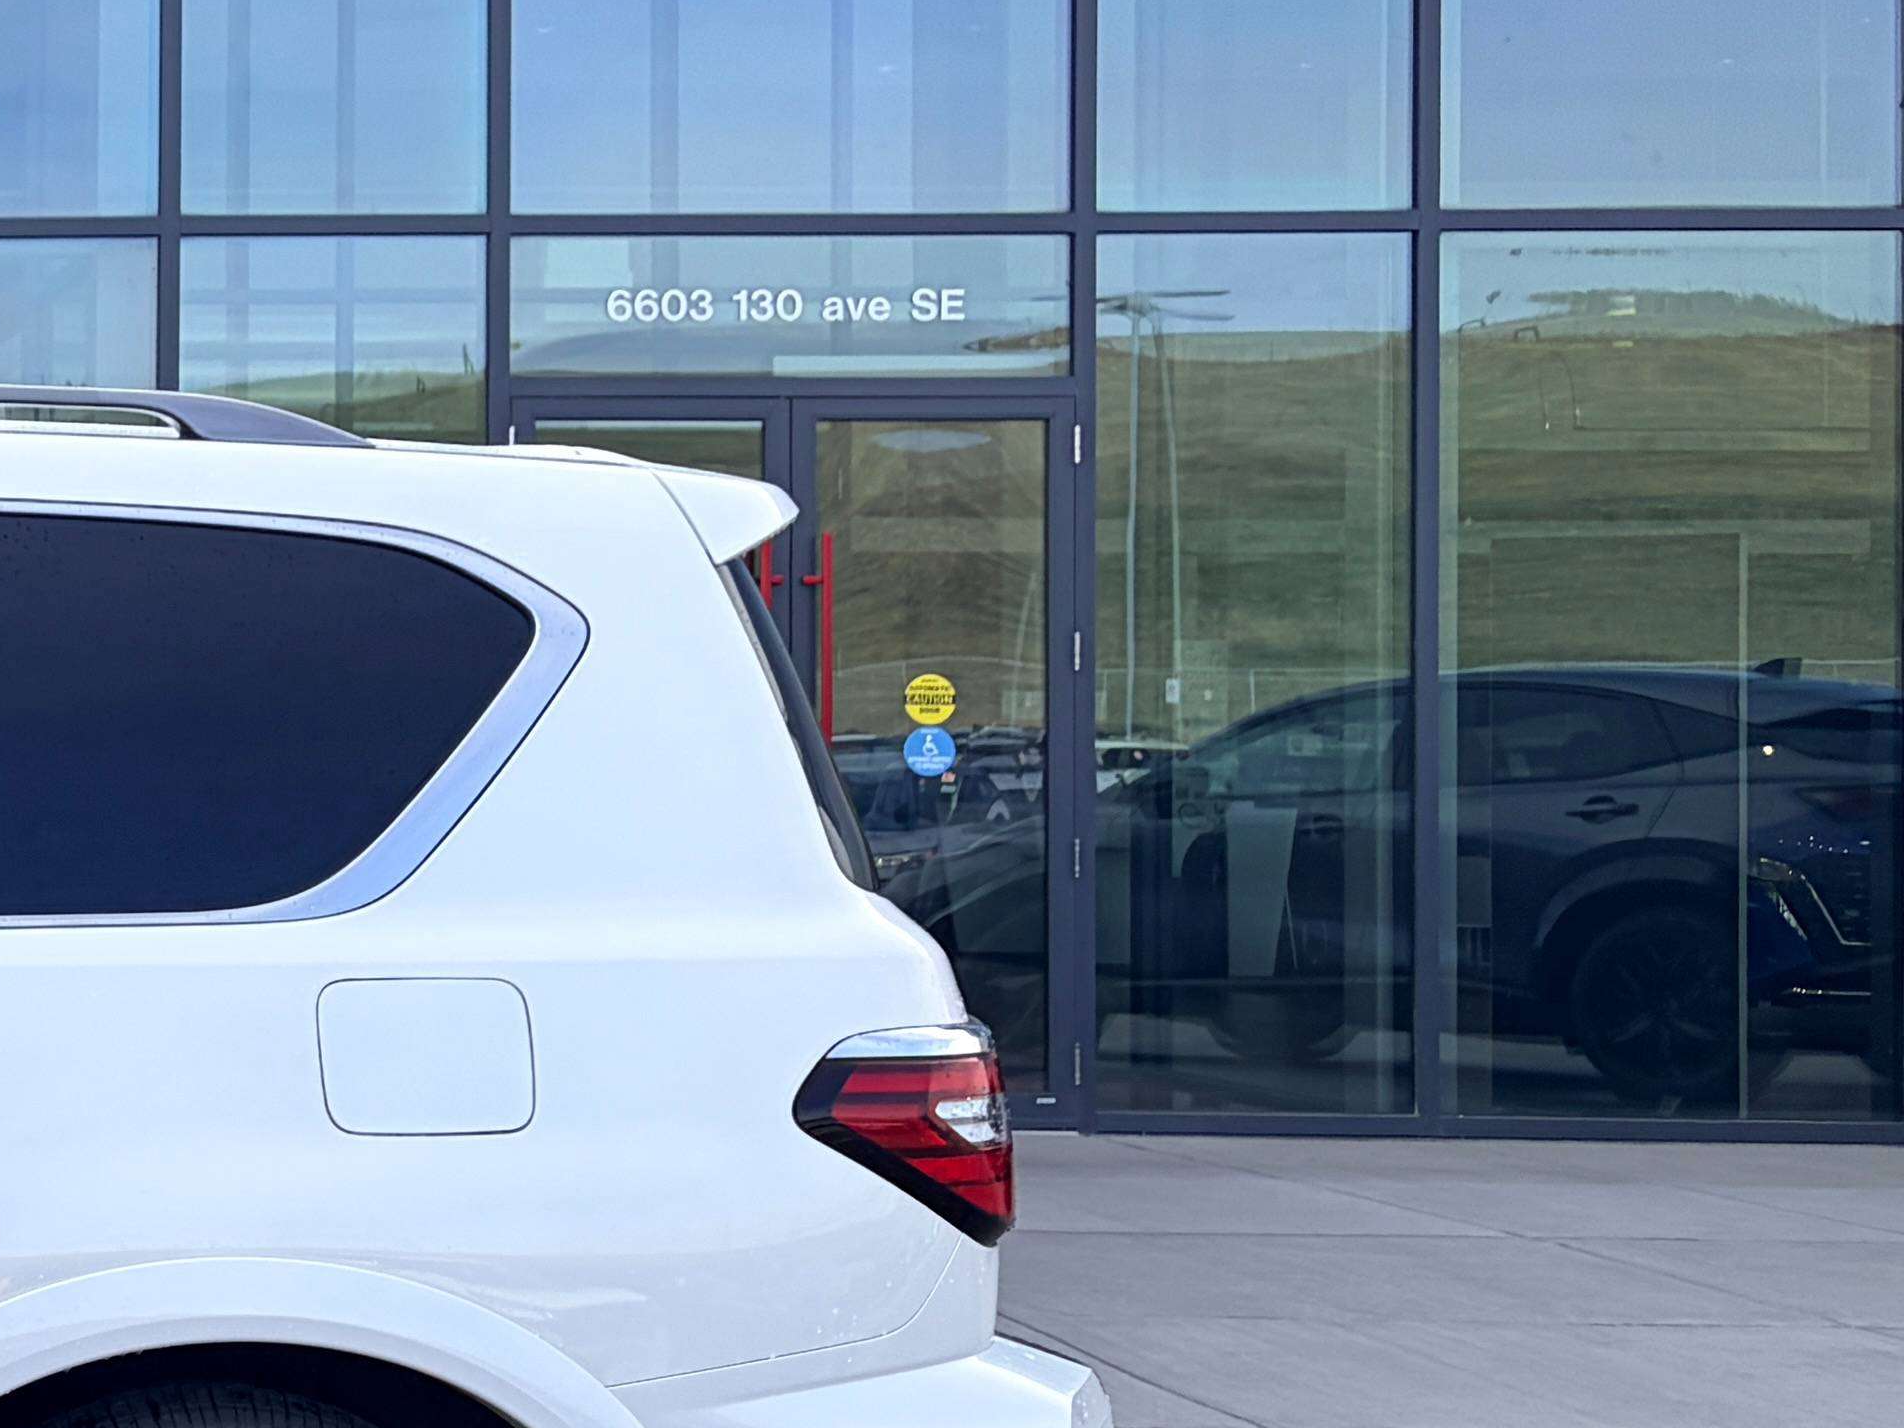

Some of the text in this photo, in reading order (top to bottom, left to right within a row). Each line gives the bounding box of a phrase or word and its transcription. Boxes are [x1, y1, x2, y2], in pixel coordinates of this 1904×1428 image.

[607, 287, 966, 322] 6603 130 ave SE
